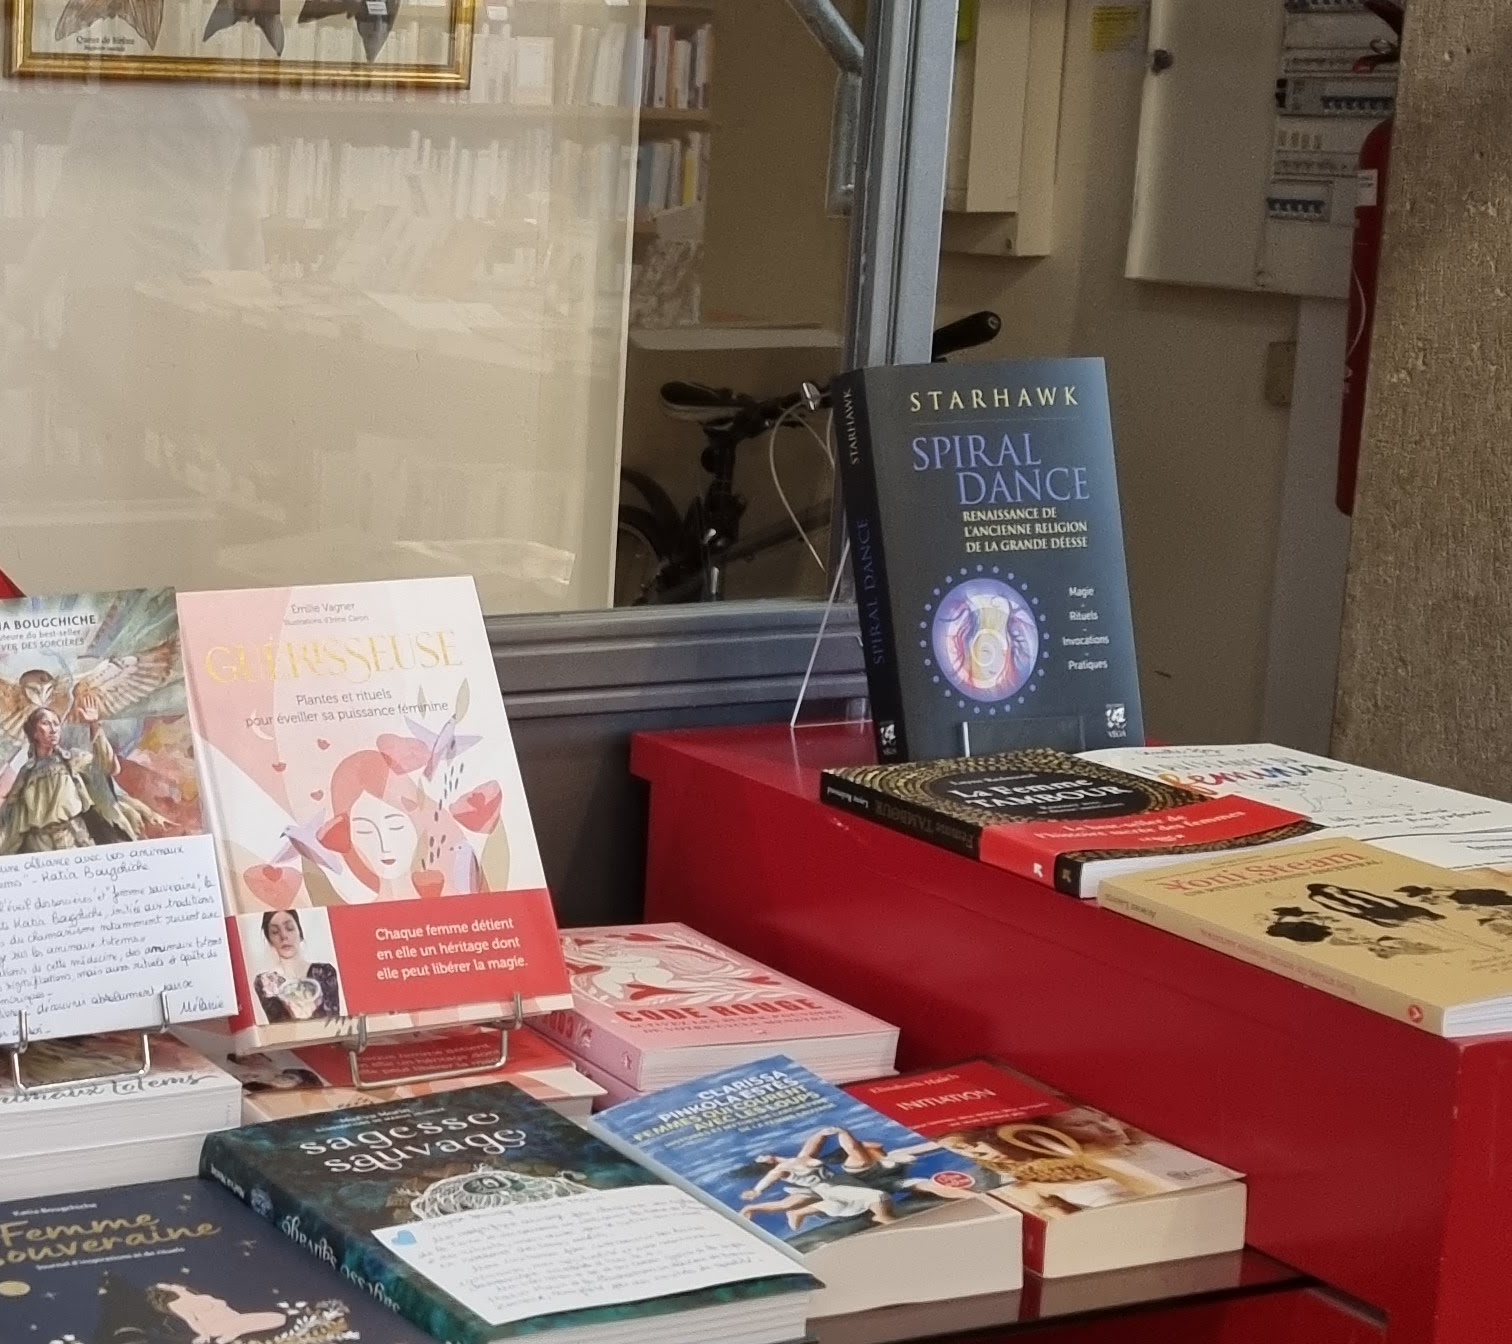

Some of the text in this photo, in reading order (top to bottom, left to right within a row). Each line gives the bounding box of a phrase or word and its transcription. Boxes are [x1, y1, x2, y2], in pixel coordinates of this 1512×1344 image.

[910, 386, 1079, 412] STARHAWK
[912, 433, 1041, 471] SPIRAL
[958, 467, 1090, 505] DANCE
[963, 507, 1057, 522] RENAISSANCE DE
[964, 521, 1087, 537] L'ANCIENNE RELIGION
[966, 535, 1087, 553] DE LA GRANDE DÉESSE
[1069, 587, 1094, 599] Magie
[14, 615, 96, 629] BOUGCHICHE
[1070, 610, 1098, 621] Rituels
[1068, 659, 1107, 671] Pratiques
[297, 689, 392, 706] Plantes et rituels
[246, 702, 449, 728] pour éveiller sa puissance féminine
[948, 779, 1093, 799] La Femme
[965, 786, 1134, 808] TAMBOUR
[1186, 811, 1245, 827] femmes
[375, 916, 514, 944] Chaque femme détient
[377, 934, 521, 960] en elle un héritage dont
[377, 954, 528, 982] elle peut libérer la magie.
[615, 1007, 708, 1022] CODE
[709, 998, 823, 1017] ROUGE
[698, 1070, 789, 1100] CLARISSA
[896, 1088, 996, 1112] INITIATION
[300, 1113, 499, 1155] sagesse
[324, 1129, 527, 1173] sauvage
